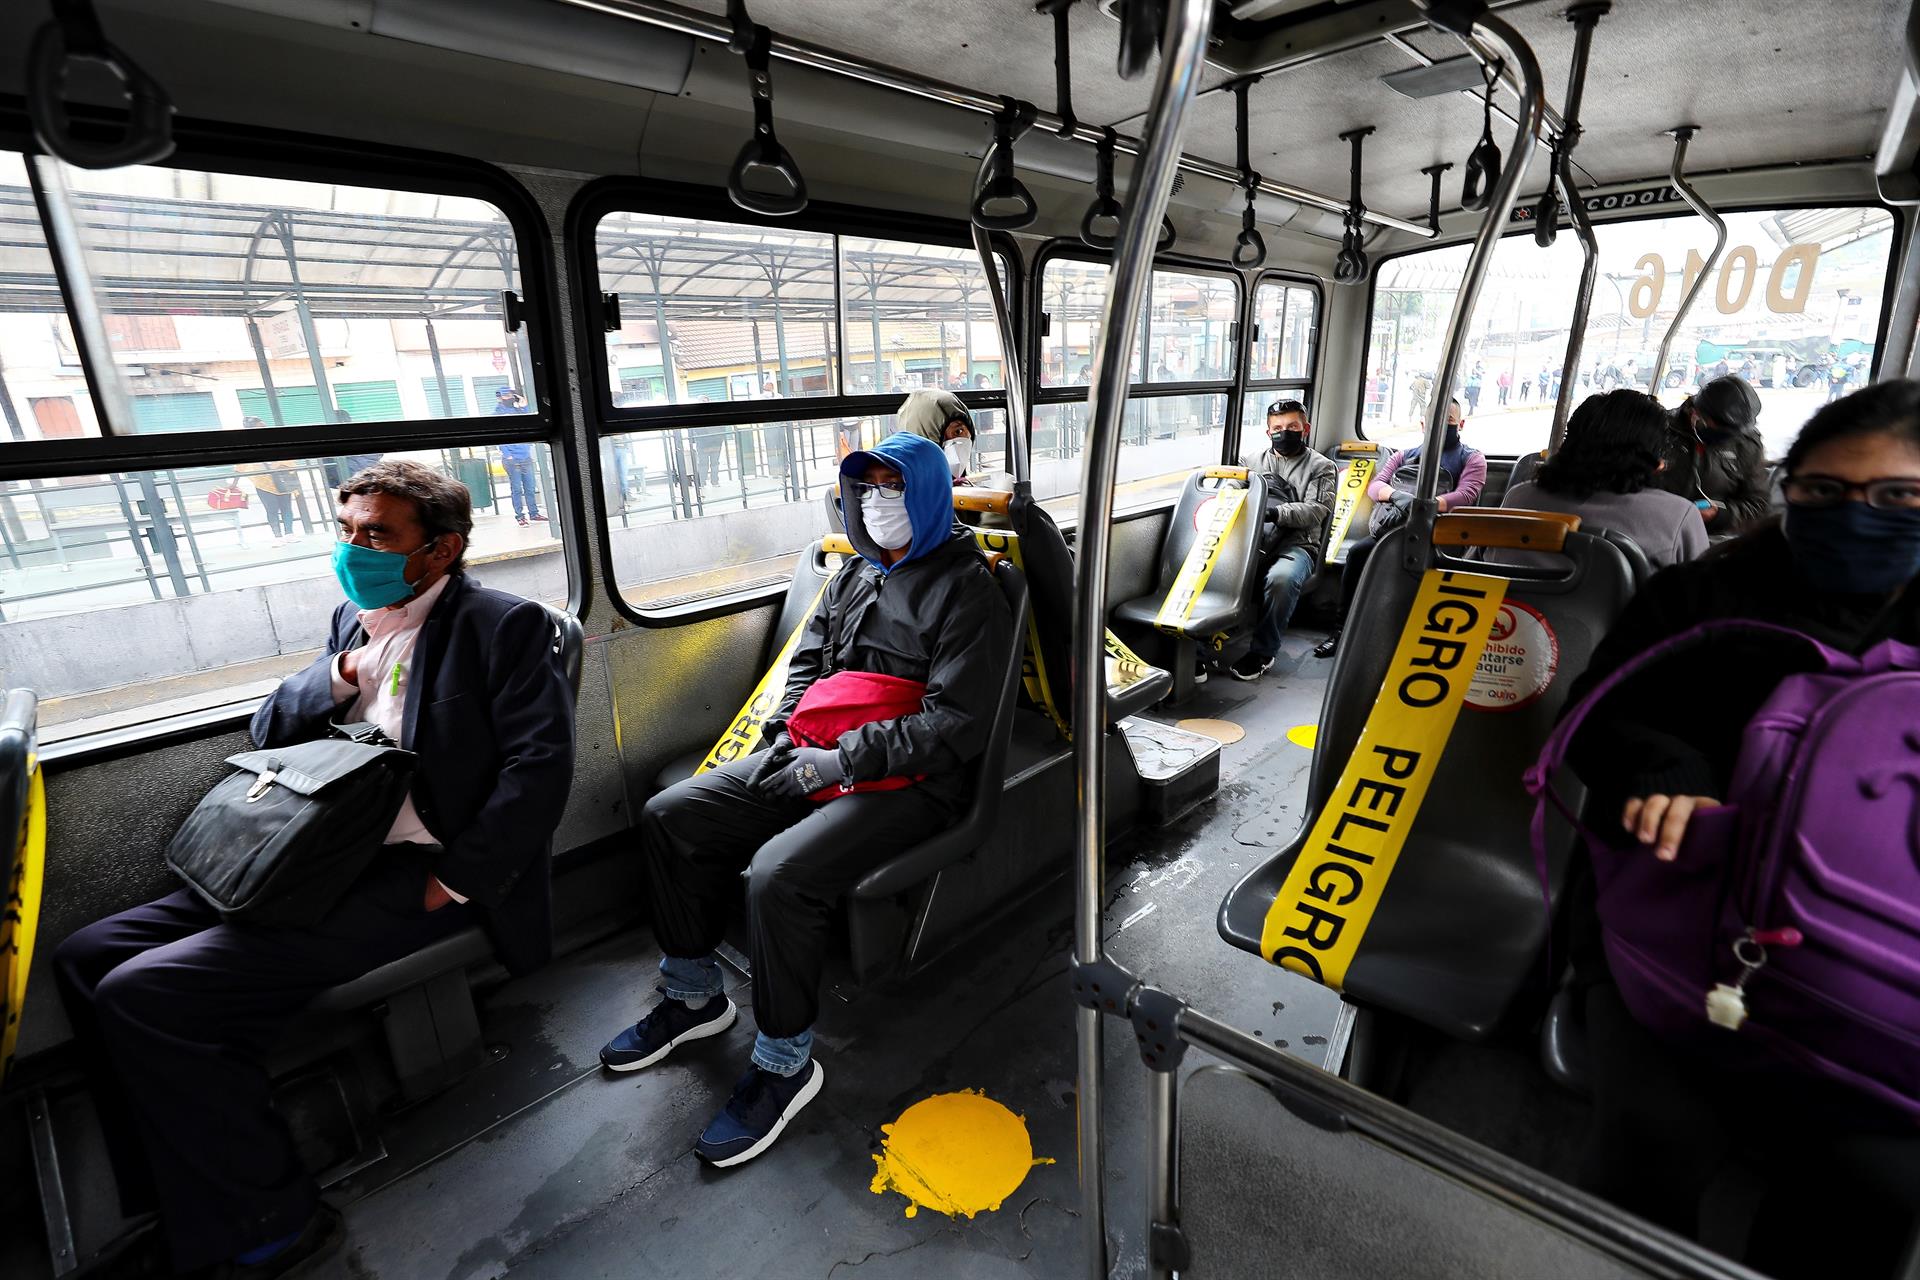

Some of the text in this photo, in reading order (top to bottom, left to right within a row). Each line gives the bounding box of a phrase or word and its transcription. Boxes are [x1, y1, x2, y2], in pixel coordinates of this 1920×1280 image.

[1398, 572, 1487, 708] IGRO
[1479, 653, 1524, 666] ntarse
[1485, 642, 1526, 656] hibido
[1273, 745, 1422, 981] PELIGRO
